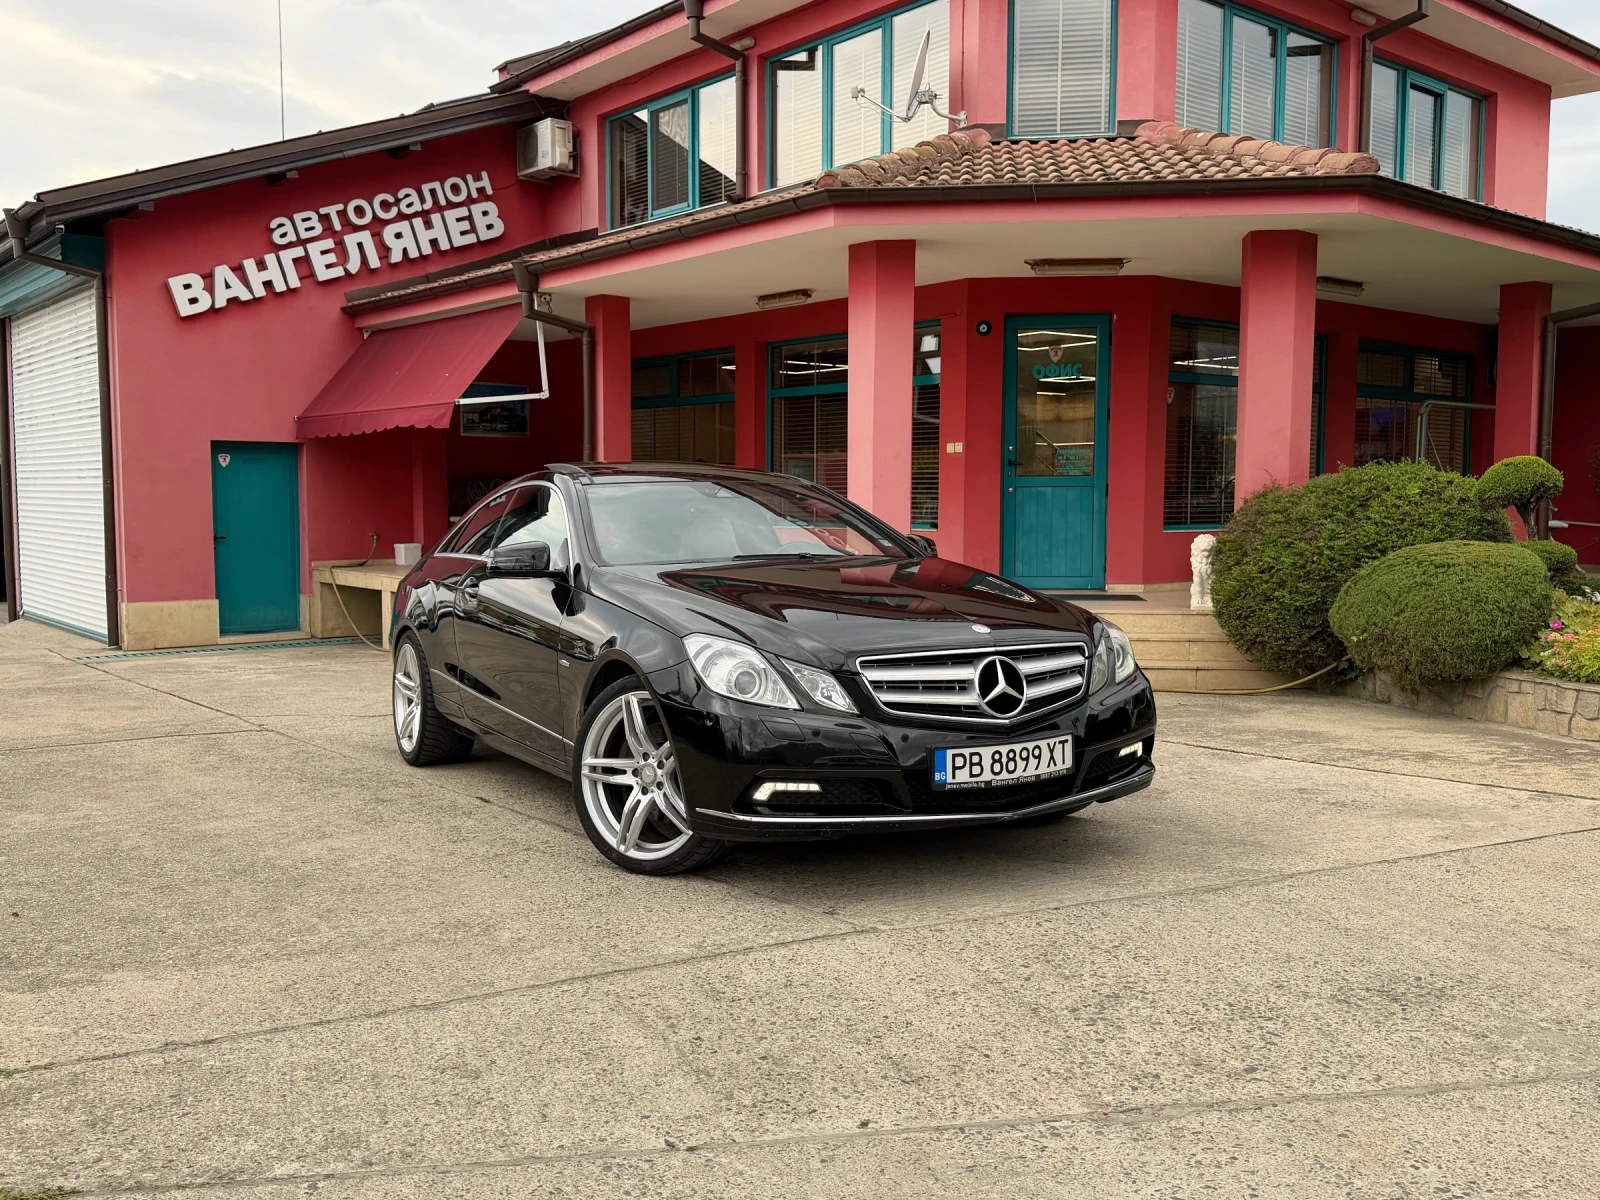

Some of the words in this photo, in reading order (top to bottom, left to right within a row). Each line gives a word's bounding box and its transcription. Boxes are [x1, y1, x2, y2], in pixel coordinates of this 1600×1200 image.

[269, 171, 493, 245] автосалон
[166, 229, 381, 317] ВАНГЕЛ
[380, 201, 505, 263] ЯНЕВ
[1032, 363, 1083, 379] ОФИС
[935, 772, 946, 780] BG
[951, 751, 984, 779] PB
[990, 744, 1042, 776] 8899
[1046, 739, 1069, 768] XT
